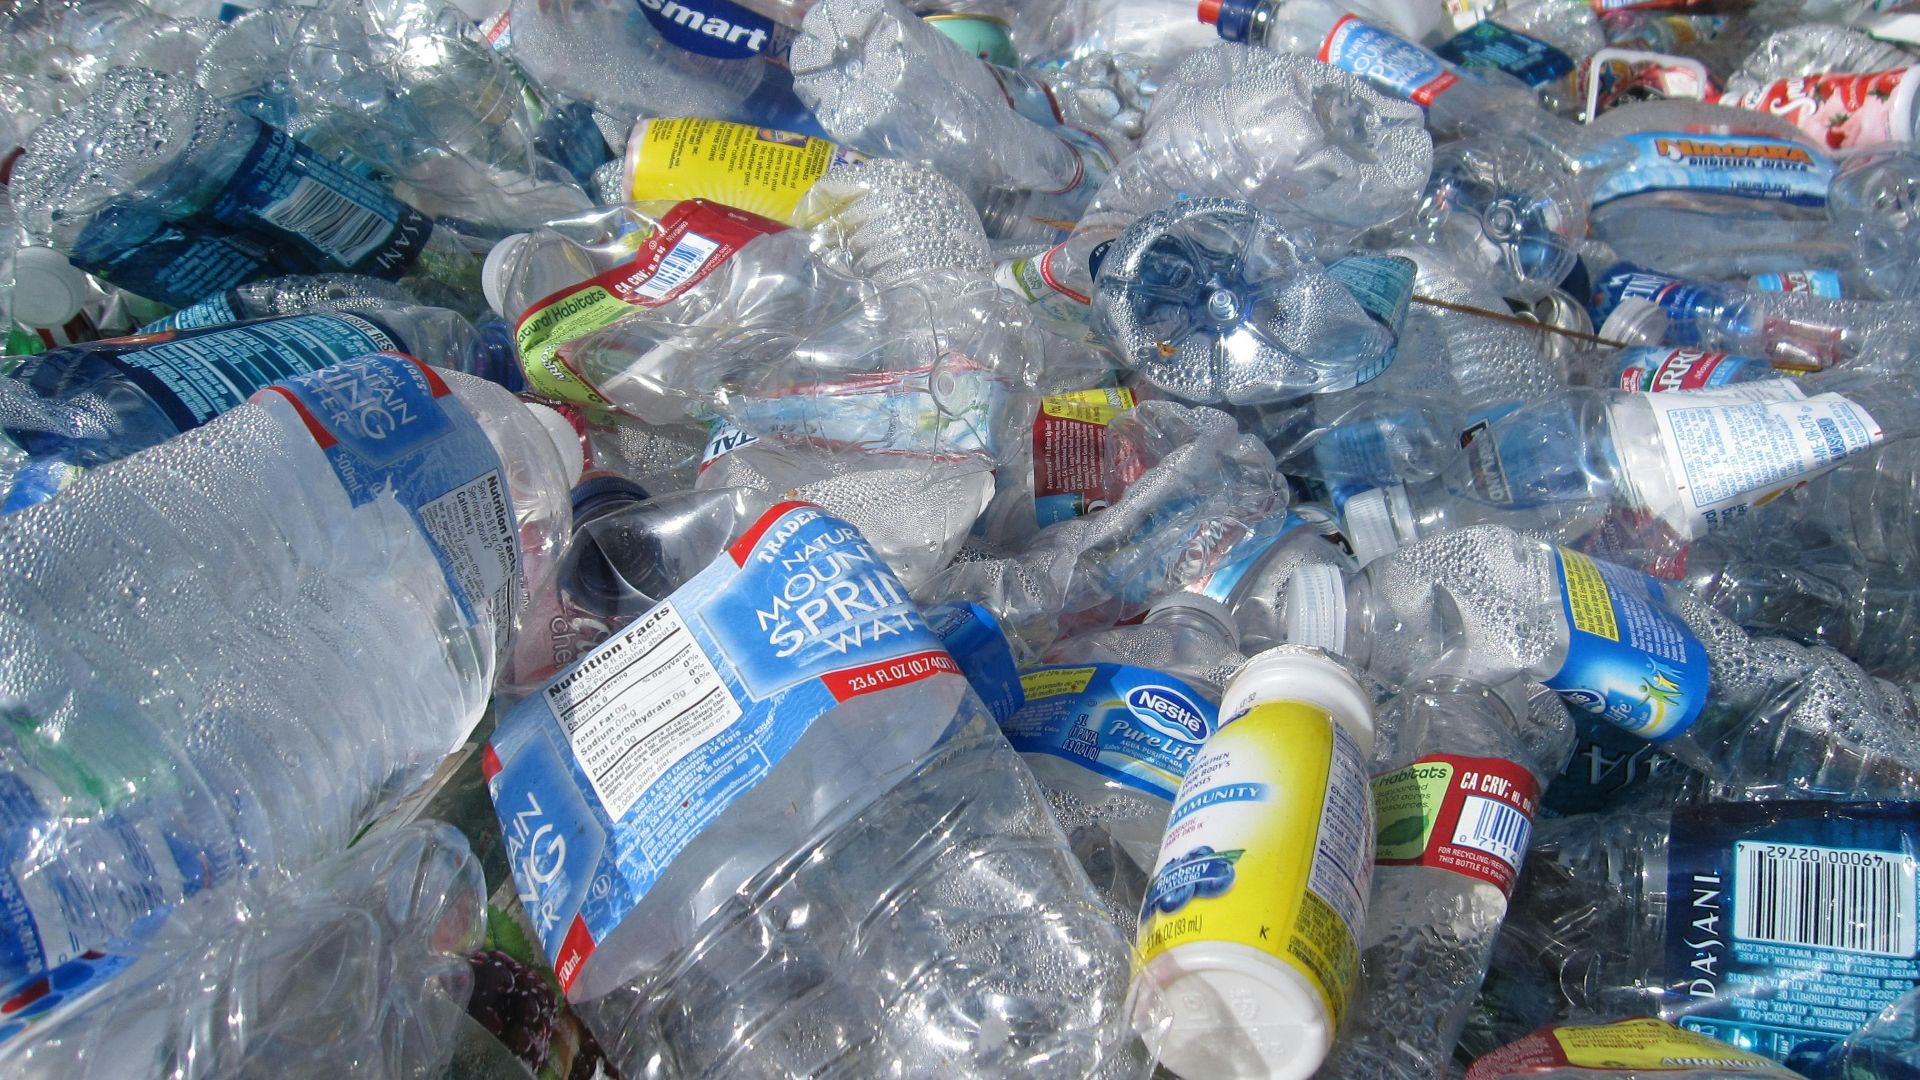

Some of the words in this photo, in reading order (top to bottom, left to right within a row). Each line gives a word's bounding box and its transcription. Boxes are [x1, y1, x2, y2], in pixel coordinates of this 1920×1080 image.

[1655, 138, 1815, 165] NIAGARA
[1689, 156, 1755, 167] PURIFIED
[1761, 160, 1808, 172] WATER
[614, 280, 632, 294] CA
[551, 286, 607, 322] Habitats
[456, 490, 472, 529] Calories
[486, 474, 510, 534] Nutrition
[756, 505, 820, 565] TRADER
[546, 641, 622, 698] Nutrition
[624, 604, 670, 644] Facts
[552, 681, 584, 706] Serving
[583, 666, 602, 683] Size
[608, 655, 618, 665] fl
[616, 649, 628, 660] oz
[628, 623, 662, 652] (240mL)
[555, 684, 593, 713] Servings
[592, 672, 607, 686] Per
[608, 644, 647, 674] Container
[646, 626, 670, 647] about
[669, 620, 677, 628] 3
[847, 672, 878, 692] 23.6
[875, 666, 893, 685] FL
[889, 661, 910, 682] OZ
[562, 700, 589, 722] Amount
[589, 690, 601, 702] Per
[601, 670, 628, 693] Serving
[575, 725, 597, 745] Total
[598, 711, 615, 727] Fat
[614, 702, 628, 715] 0g
[681, 652, 699, 668] 0%
[566, 702, 600, 731] Calories
[600, 695, 608, 703] 0
[578, 724, 615, 756] Sodium
[614, 707, 637, 728] 0mg
[687, 661, 705, 676] 0%
[585, 744, 609, 766] Total
[608, 697, 672, 746] Carbohydrate
[671, 687, 687, 702] 0g
[692, 669, 711, 685] 0%
[1077, 728, 1098, 743] PINTA
[1108, 717, 1162, 748] Pure
[591, 746, 625, 776] Protein
[622, 733, 638, 748] 0g
[654, 745, 678, 766] Values
[1120, 739, 1140, 750] AGUA
[1142, 746, 1183, 769] PURIFICADA
[1200, 760, 1231, 776] BODY'S
[1459, 771, 1478, 790] CA
[1480, 774, 1512, 798] CRV;
[1459, 834, 1466, 842] 0
[1735, 841, 1745, 853] 4
[1437, 846, 1451, 856] FOR
[1765, 844, 1820, 862] 02762
[1826, 849, 1883, 866] 49000
[1438, 855, 1455, 865] THIS
[1455, 858, 1480, 871] BOTTLE
[1155, 860, 1211, 889] Blueberry
[1257, 924, 1271, 940] K
[1689, 874, 1723, 1000] DASANI
[1733, 941, 1811, 958] WWW.DASANI.COM
[1737, 951, 1768, 962] PLEASE
[1853, 963, 1888, 975] QUALITY
[1862, 976, 1879, 987] THE
[1777, 988, 1788, 999] OF
[1789, 989, 1835, 1006] AUTHORITY
[1836, 995, 1866, 1008] UNDER
[1739, 1008, 1784, 1023] COCA-COLA
[1785, 1014, 1802, 1025] THE
[1802, 1016, 1814, 1025] OF
[1815, 1017, 1853, 1030] MEMBER
